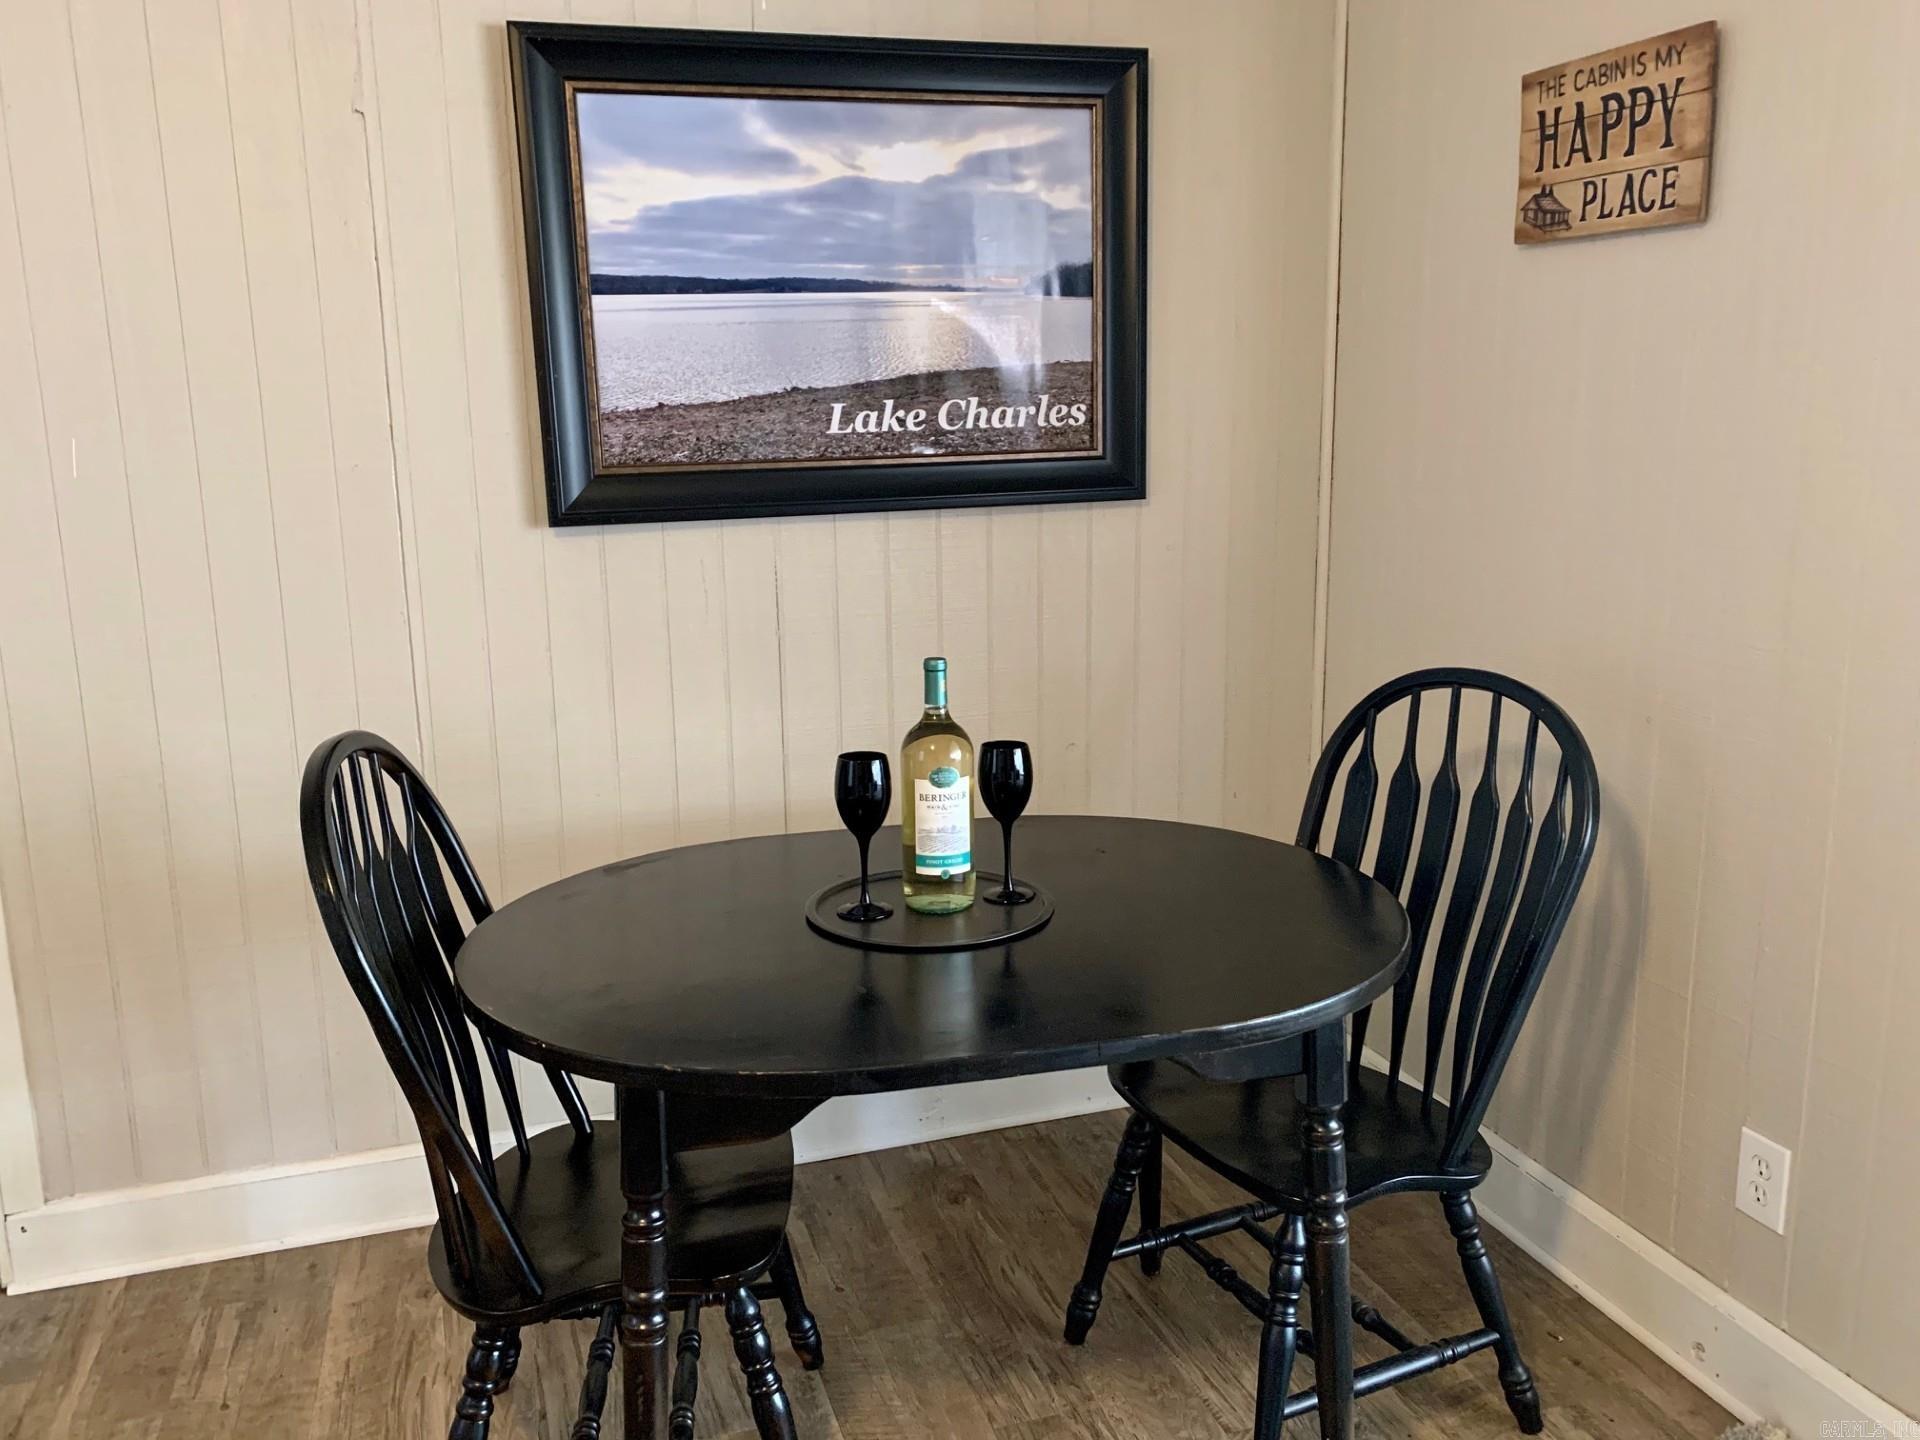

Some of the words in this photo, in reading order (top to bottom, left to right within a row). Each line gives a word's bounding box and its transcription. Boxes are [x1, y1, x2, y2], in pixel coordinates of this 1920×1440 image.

[1536, 74, 1567, 103] THE
[1574, 56, 1626, 92] CABIN
[1630, 51, 1647, 78] IS
[1655, 42, 1687, 72] MY
[1534, 76, 1686, 173] HAPPY
[1579, 165, 1679, 222] PLACE
[826, 399, 927, 434] Lake
[938, 394, 1087, 431] Charles
